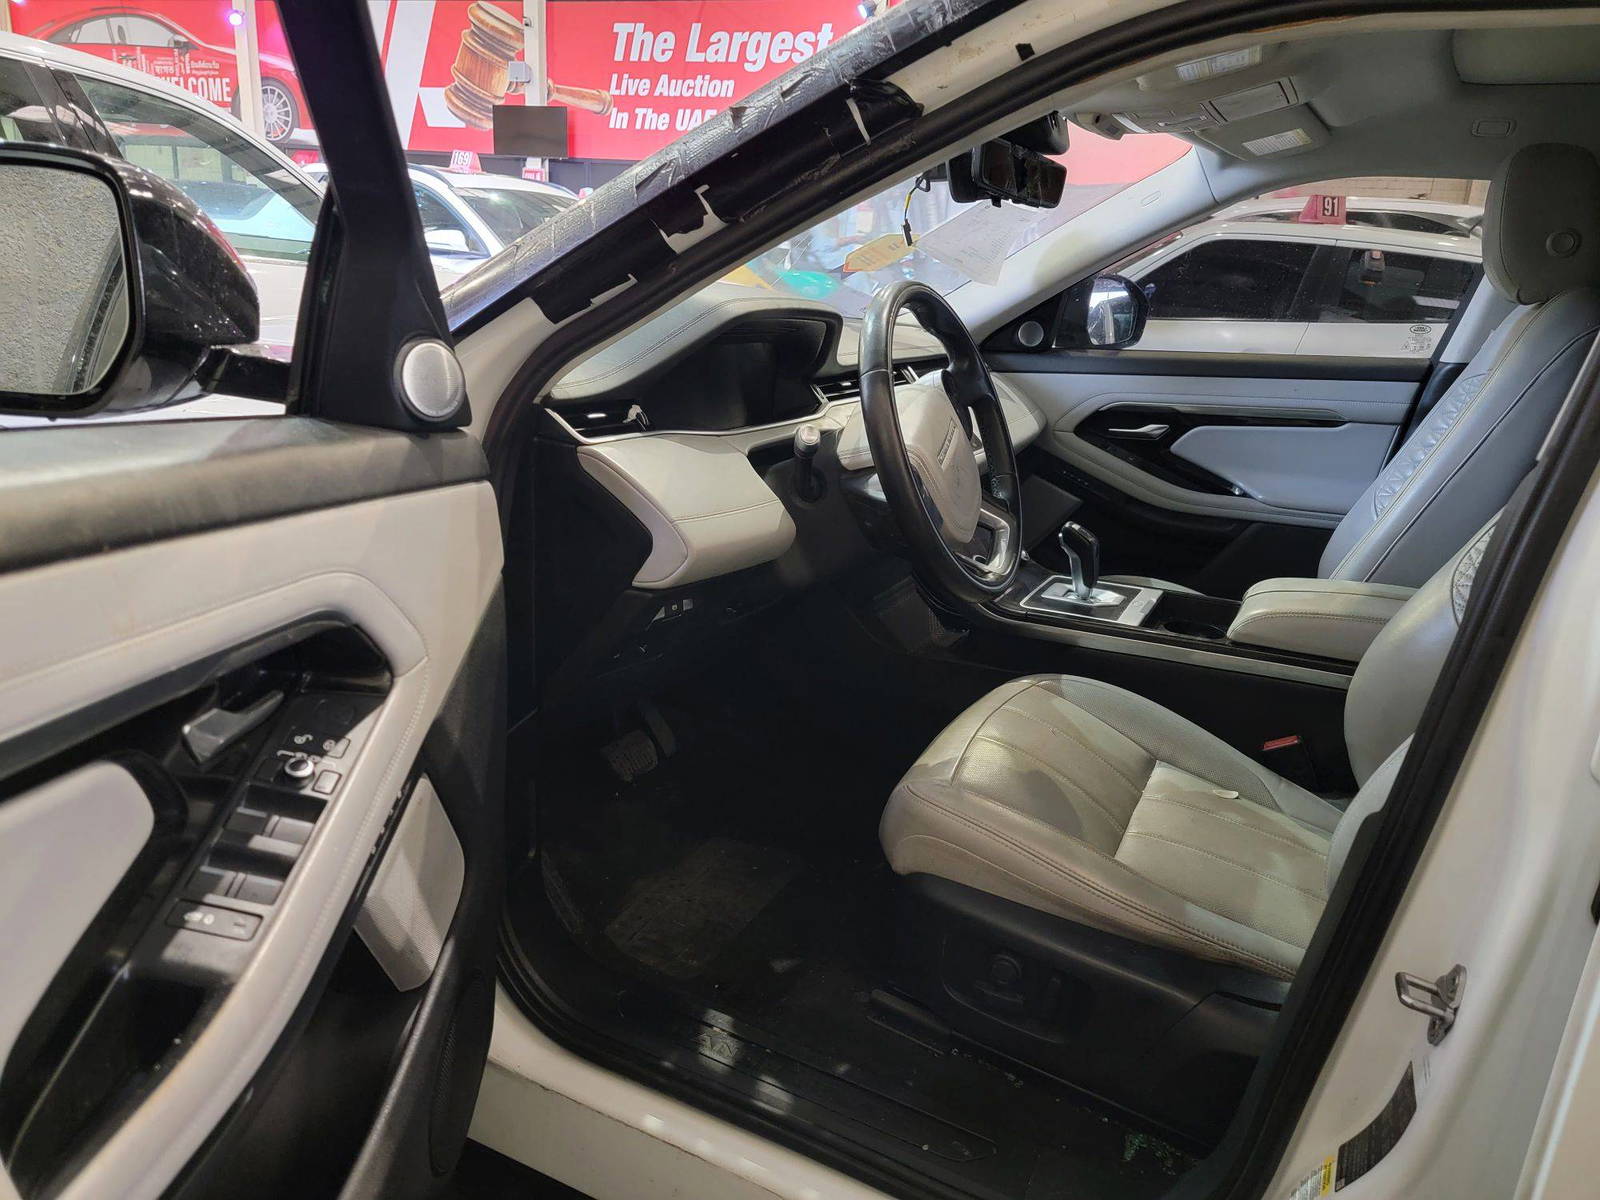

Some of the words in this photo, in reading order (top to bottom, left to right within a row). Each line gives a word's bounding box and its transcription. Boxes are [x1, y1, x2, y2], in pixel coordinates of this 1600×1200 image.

[612, 22, 676, 63] The
[685, 22, 834, 73] Largest
[160, 76, 231, 101] COME
[609, 73, 651, 97] Live
[653, 74, 735, 98] Auction
[608, 107, 629, 129] In
[634, 108, 670, 130] The
[455, 151, 471, 166] 169
[1324, 196, 1338, 216] 91
